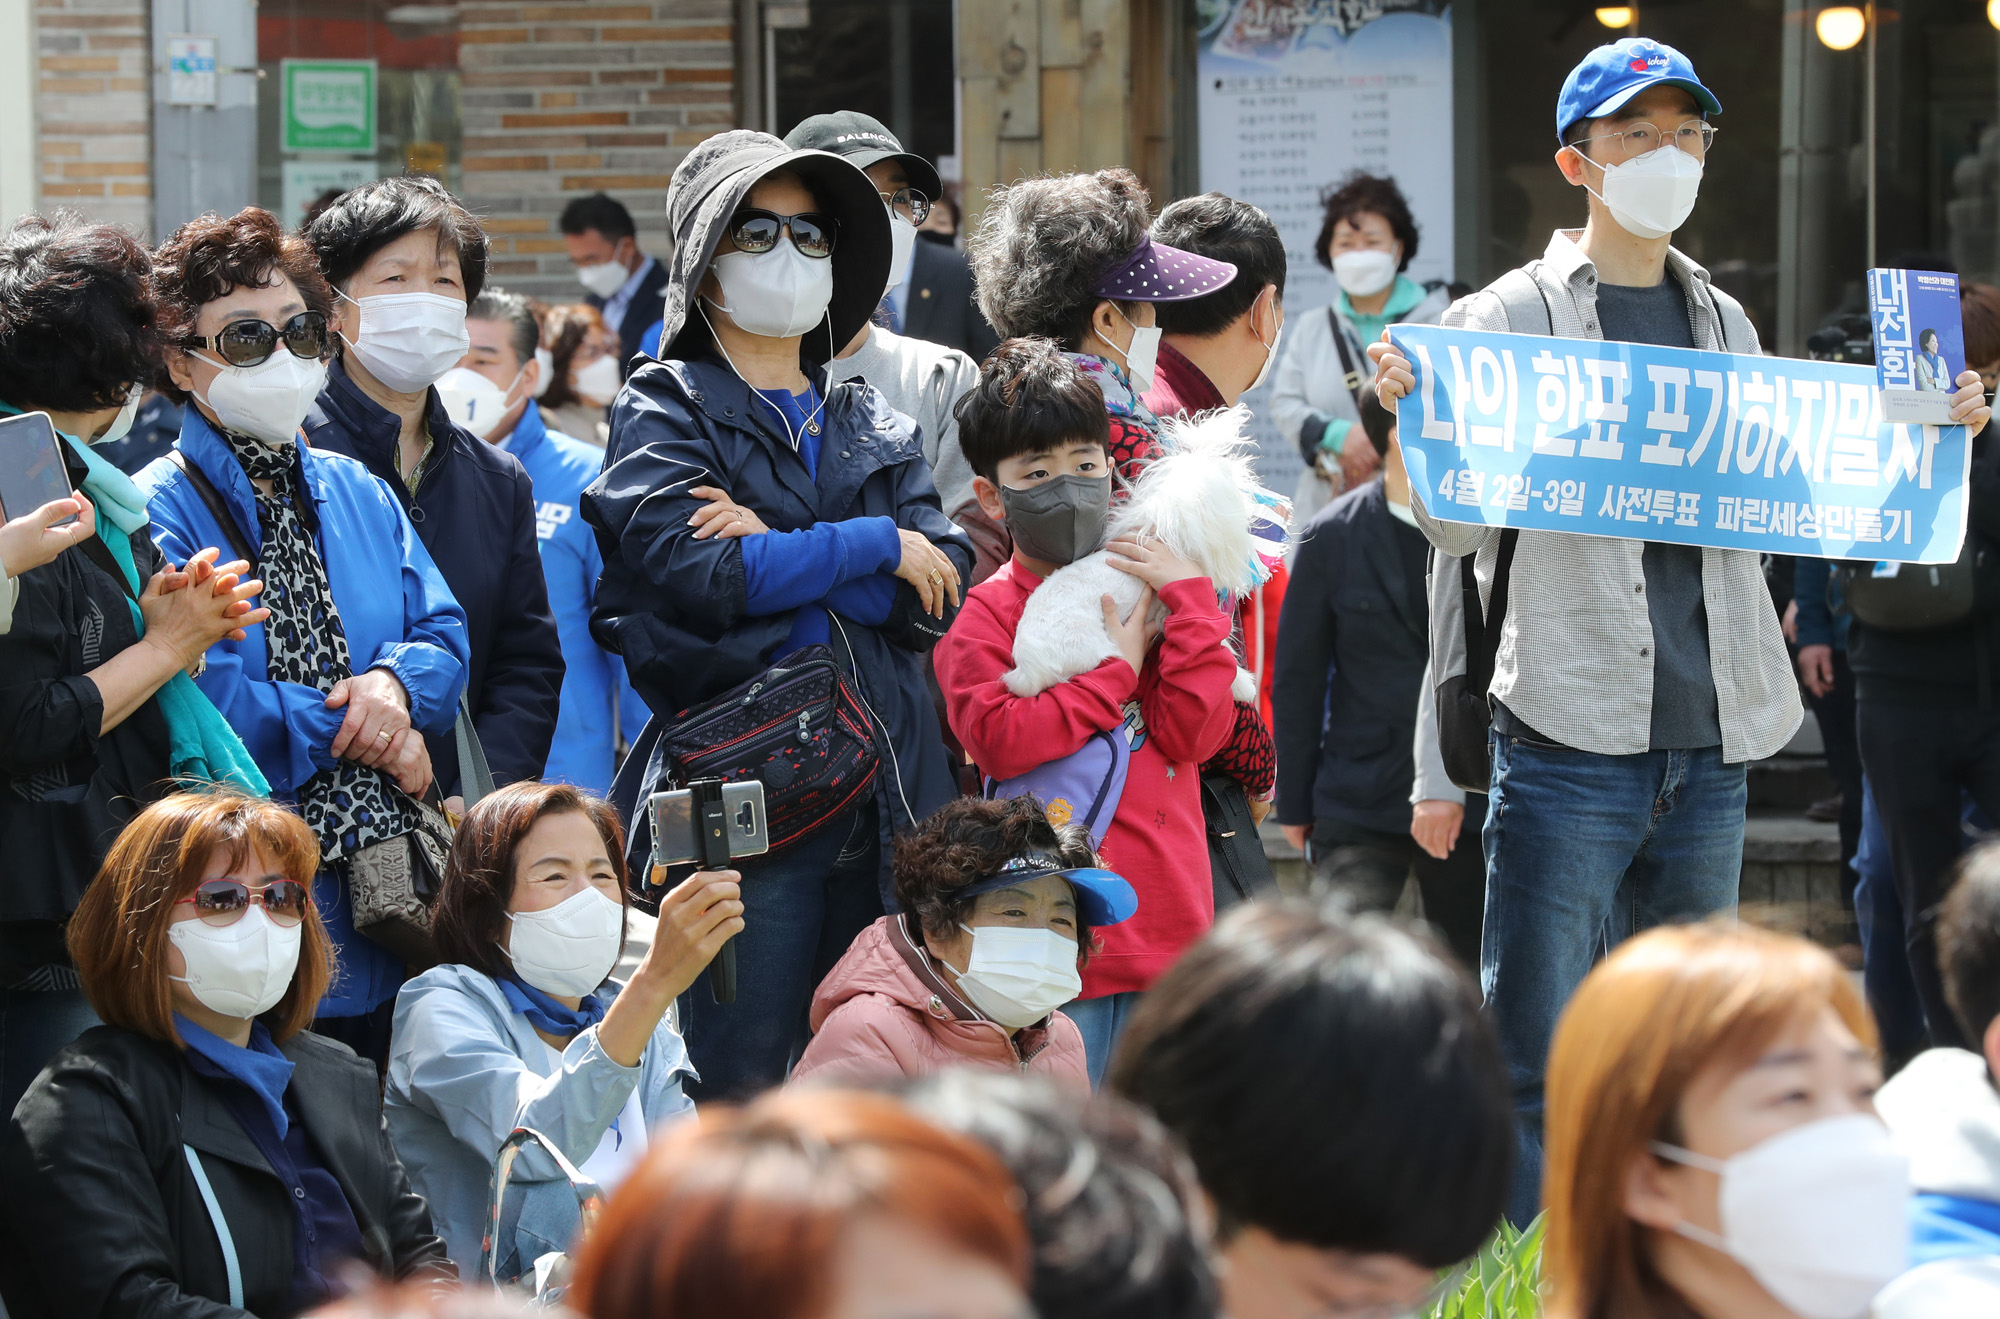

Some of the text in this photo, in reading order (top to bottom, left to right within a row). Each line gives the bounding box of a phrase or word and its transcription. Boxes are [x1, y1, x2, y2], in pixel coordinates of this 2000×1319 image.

[837, 132, 904, 153] BALENCIA
[1875, 268, 1916, 391] 대전환
[466, 398, 476, 421] 1
[1415, 344, 1518, 452] 나의
[1531, 349, 1629, 460] 한표
[1438, 469, 1912, 544] 4월 2일-3일 사전투표 파란세상만들기
